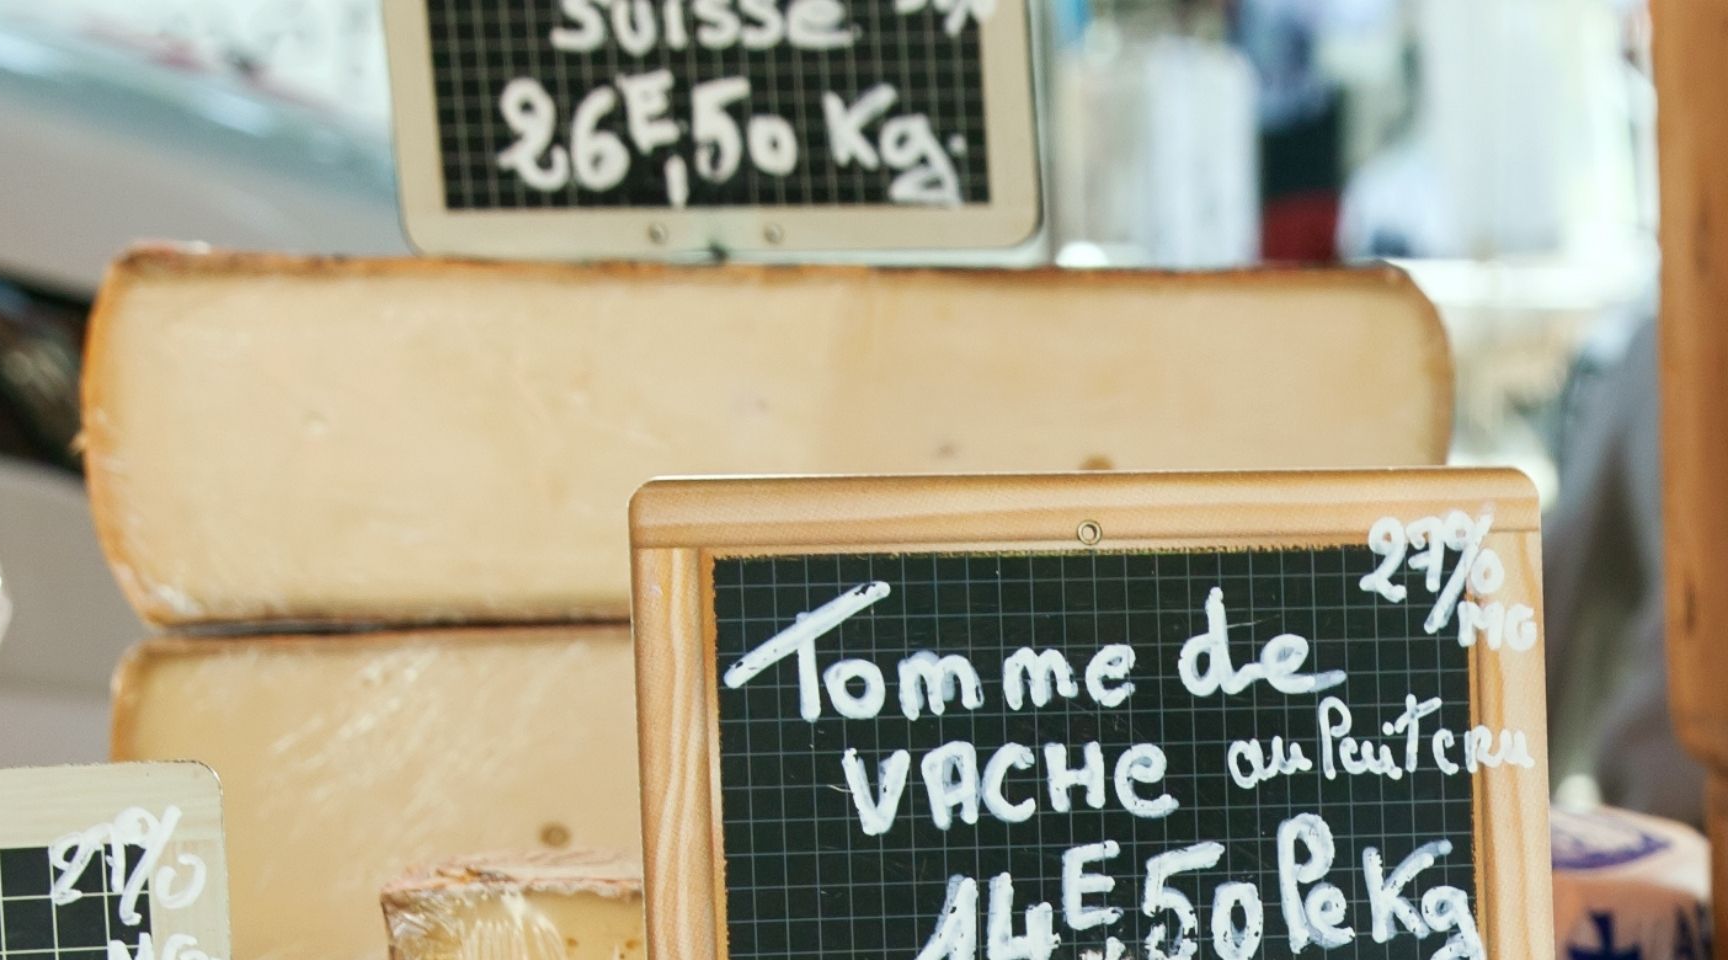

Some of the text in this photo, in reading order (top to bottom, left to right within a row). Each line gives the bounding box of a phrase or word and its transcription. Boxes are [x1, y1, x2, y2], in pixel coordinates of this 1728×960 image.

[724, 581, 1346, 722] Tomme de
[1457, 599, 1537, 651] MG
